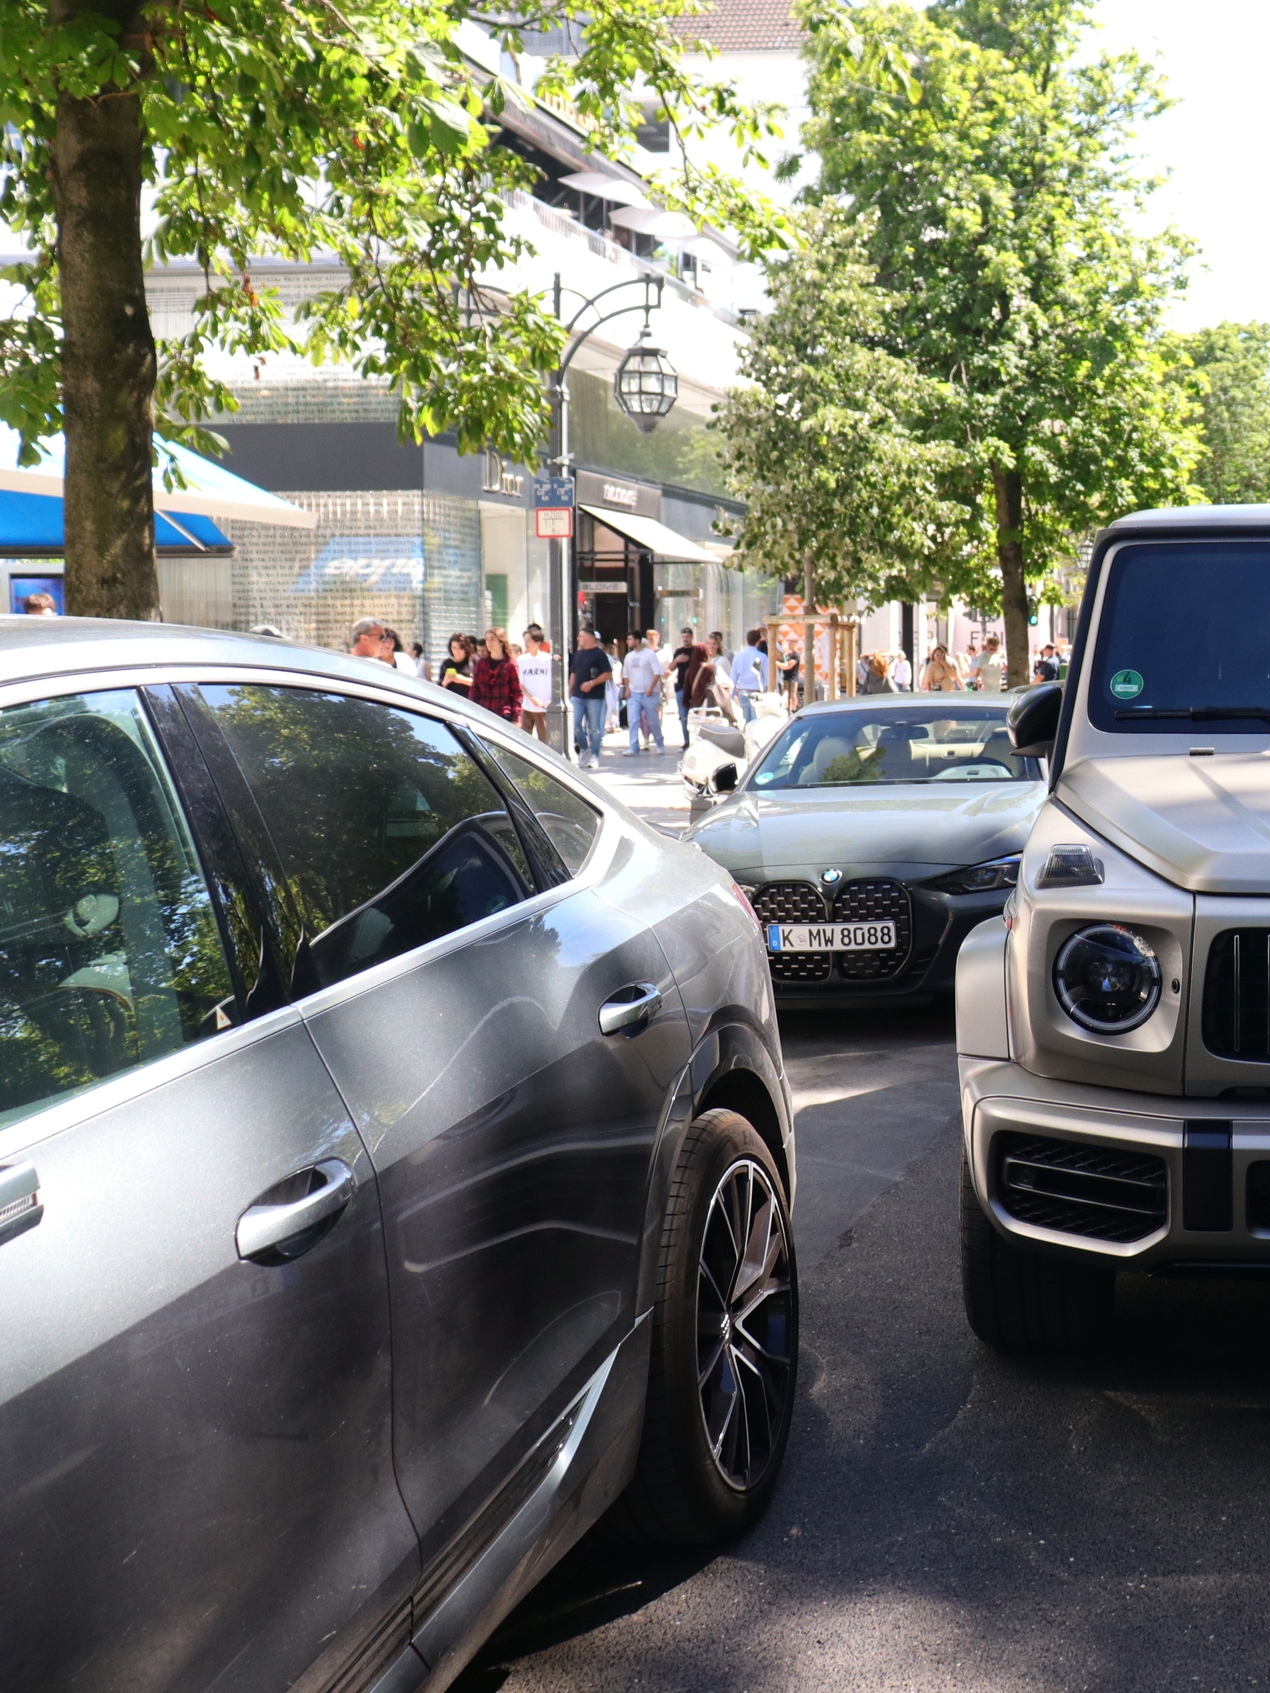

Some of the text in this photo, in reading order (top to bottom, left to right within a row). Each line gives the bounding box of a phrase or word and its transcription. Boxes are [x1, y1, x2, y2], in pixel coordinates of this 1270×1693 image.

[482, 448, 525, 497] Dior
[580, 582, 619, 592] BLOME
[1122, 672, 1132, 684] 4
[782, 926, 892, 948] K MW 8088
